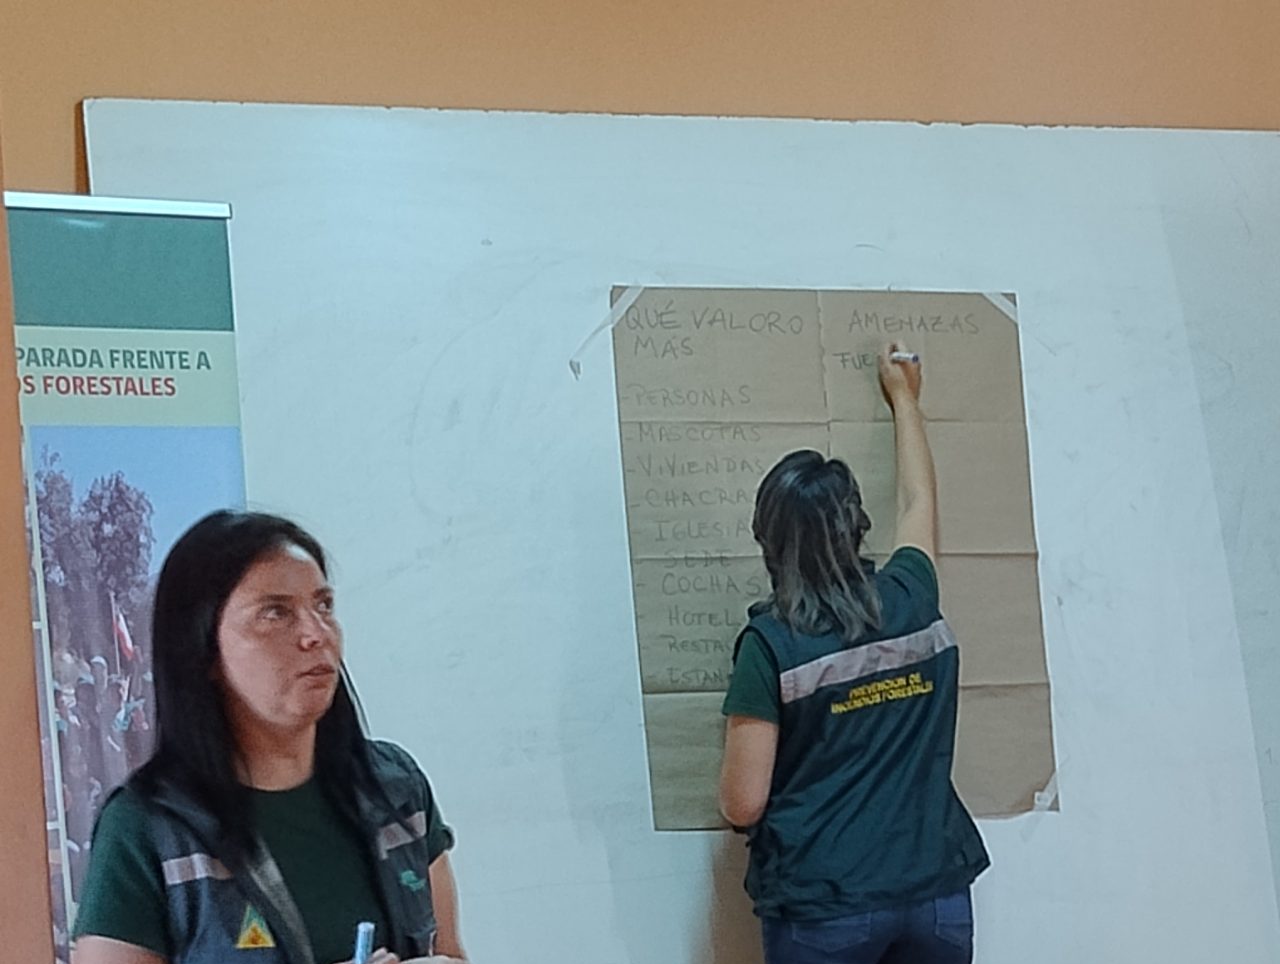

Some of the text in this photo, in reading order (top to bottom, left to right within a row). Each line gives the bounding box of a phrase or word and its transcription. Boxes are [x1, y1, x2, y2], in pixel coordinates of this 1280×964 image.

[625, 300, 803, 335] QUÉ VALORO
[849, 310, 980, 335] AMENAZAS
[634, 335, 694, 359] MÁS
[110, 350, 190, 369] FRENTE
[197, 351, 211, 370] A
[44, 376, 176, 396] FORESTALES
[626, 383, 751, 408] PERSONAS
[639, 421, 762, 443] MASCOTAS
[637, 453, 766, 477] VIVIENDAS
[645, 488, 753, 508] CHACRA
[662, 572, 762, 597] COCHAS
